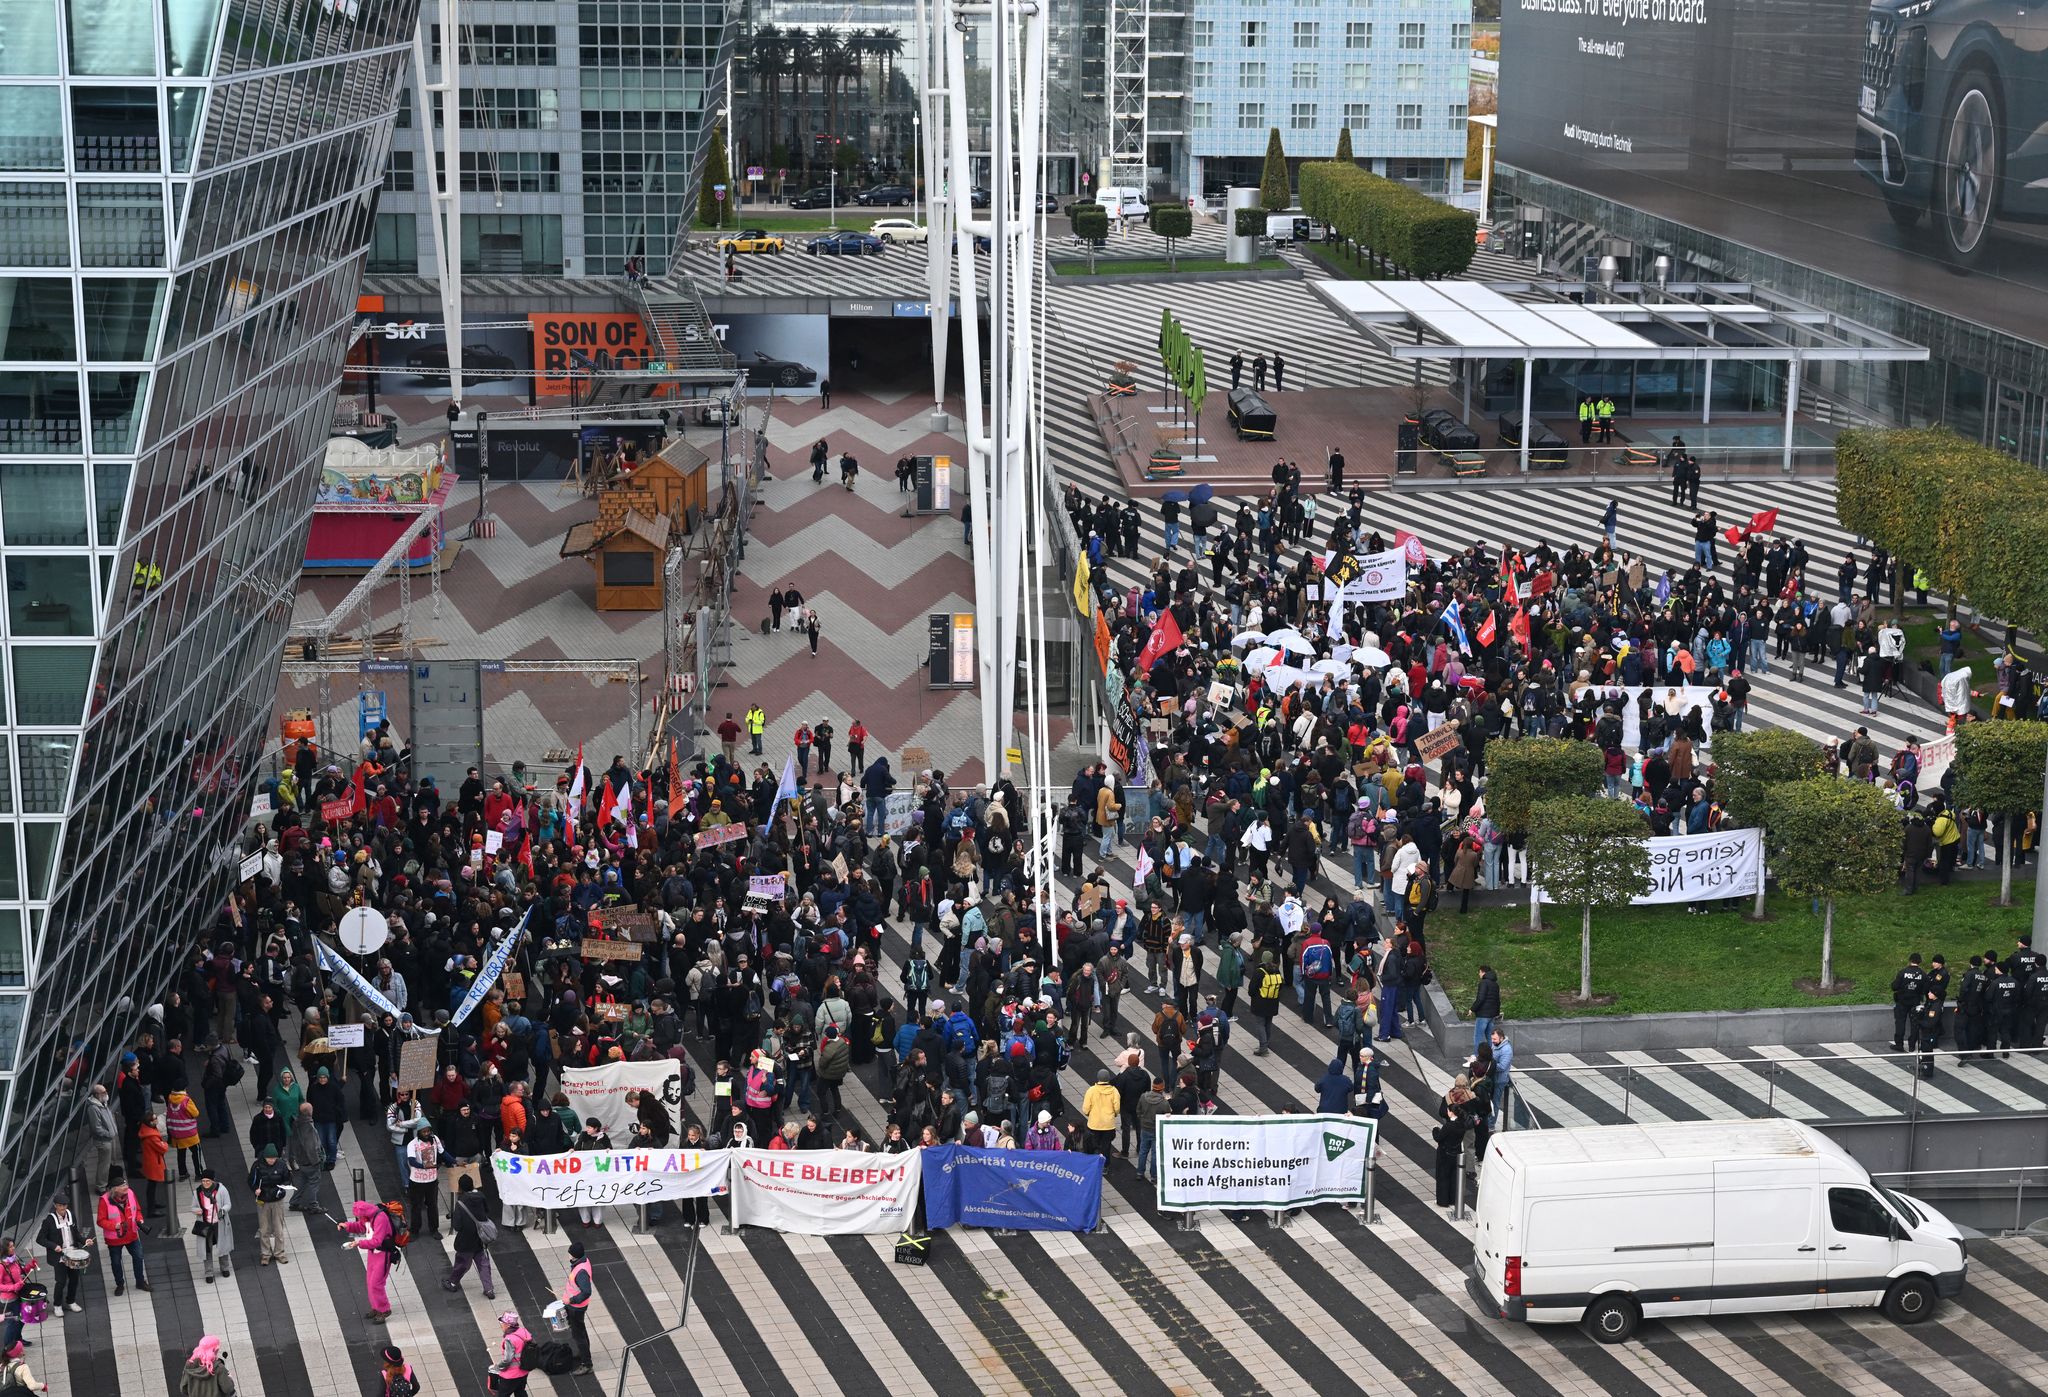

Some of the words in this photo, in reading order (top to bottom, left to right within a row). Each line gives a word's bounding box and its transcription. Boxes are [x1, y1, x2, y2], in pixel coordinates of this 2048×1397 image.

[1602, 0, 1649, 26] everyone
[1651, 0, 1666, 21] on
[1578, 37, 1588, 53] The
[1587, 39, 1605, 55] all-new
[1605, 41, 1616, 57] Audi
[1564, 122, 1576, 139] Audi
[1575, 125, 1599, 148] Vorsprung
[1599, 131, 1613, 148] durch
[1613, 134, 1633, 153] Technik
[850, 303, 873, 311] Hilton
[544, 322, 597, 346] SON
[605, 322, 637, 346] OF
[498, 441, 540, 452] Revolut
[564, 1080, 583, 1088] Crazy
[1172, 1138, 1194, 1151] Wir
[1197, 1138, 1250, 1151] fordern:
[1329, 1138, 1346, 1147] not
[495, 1156, 582, 1175] #STAND
[594, 1155, 649, 1172] WITH
[742, 1159, 794, 1179] ALLE
[942, 1154, 1006, 1174] Solidarität
[1009, 1159, 1085, 1185] verteidigen!
[1172, 1157, 1209, 1169] Keine
[1212, 1156, 1310, 1170] Abschiebungen
[1173, 1175, 1204, 1187] nach
[1207, 1174, 1291, 1189] Afghanistan!
[532, 1178, 663, 1207] refugees
